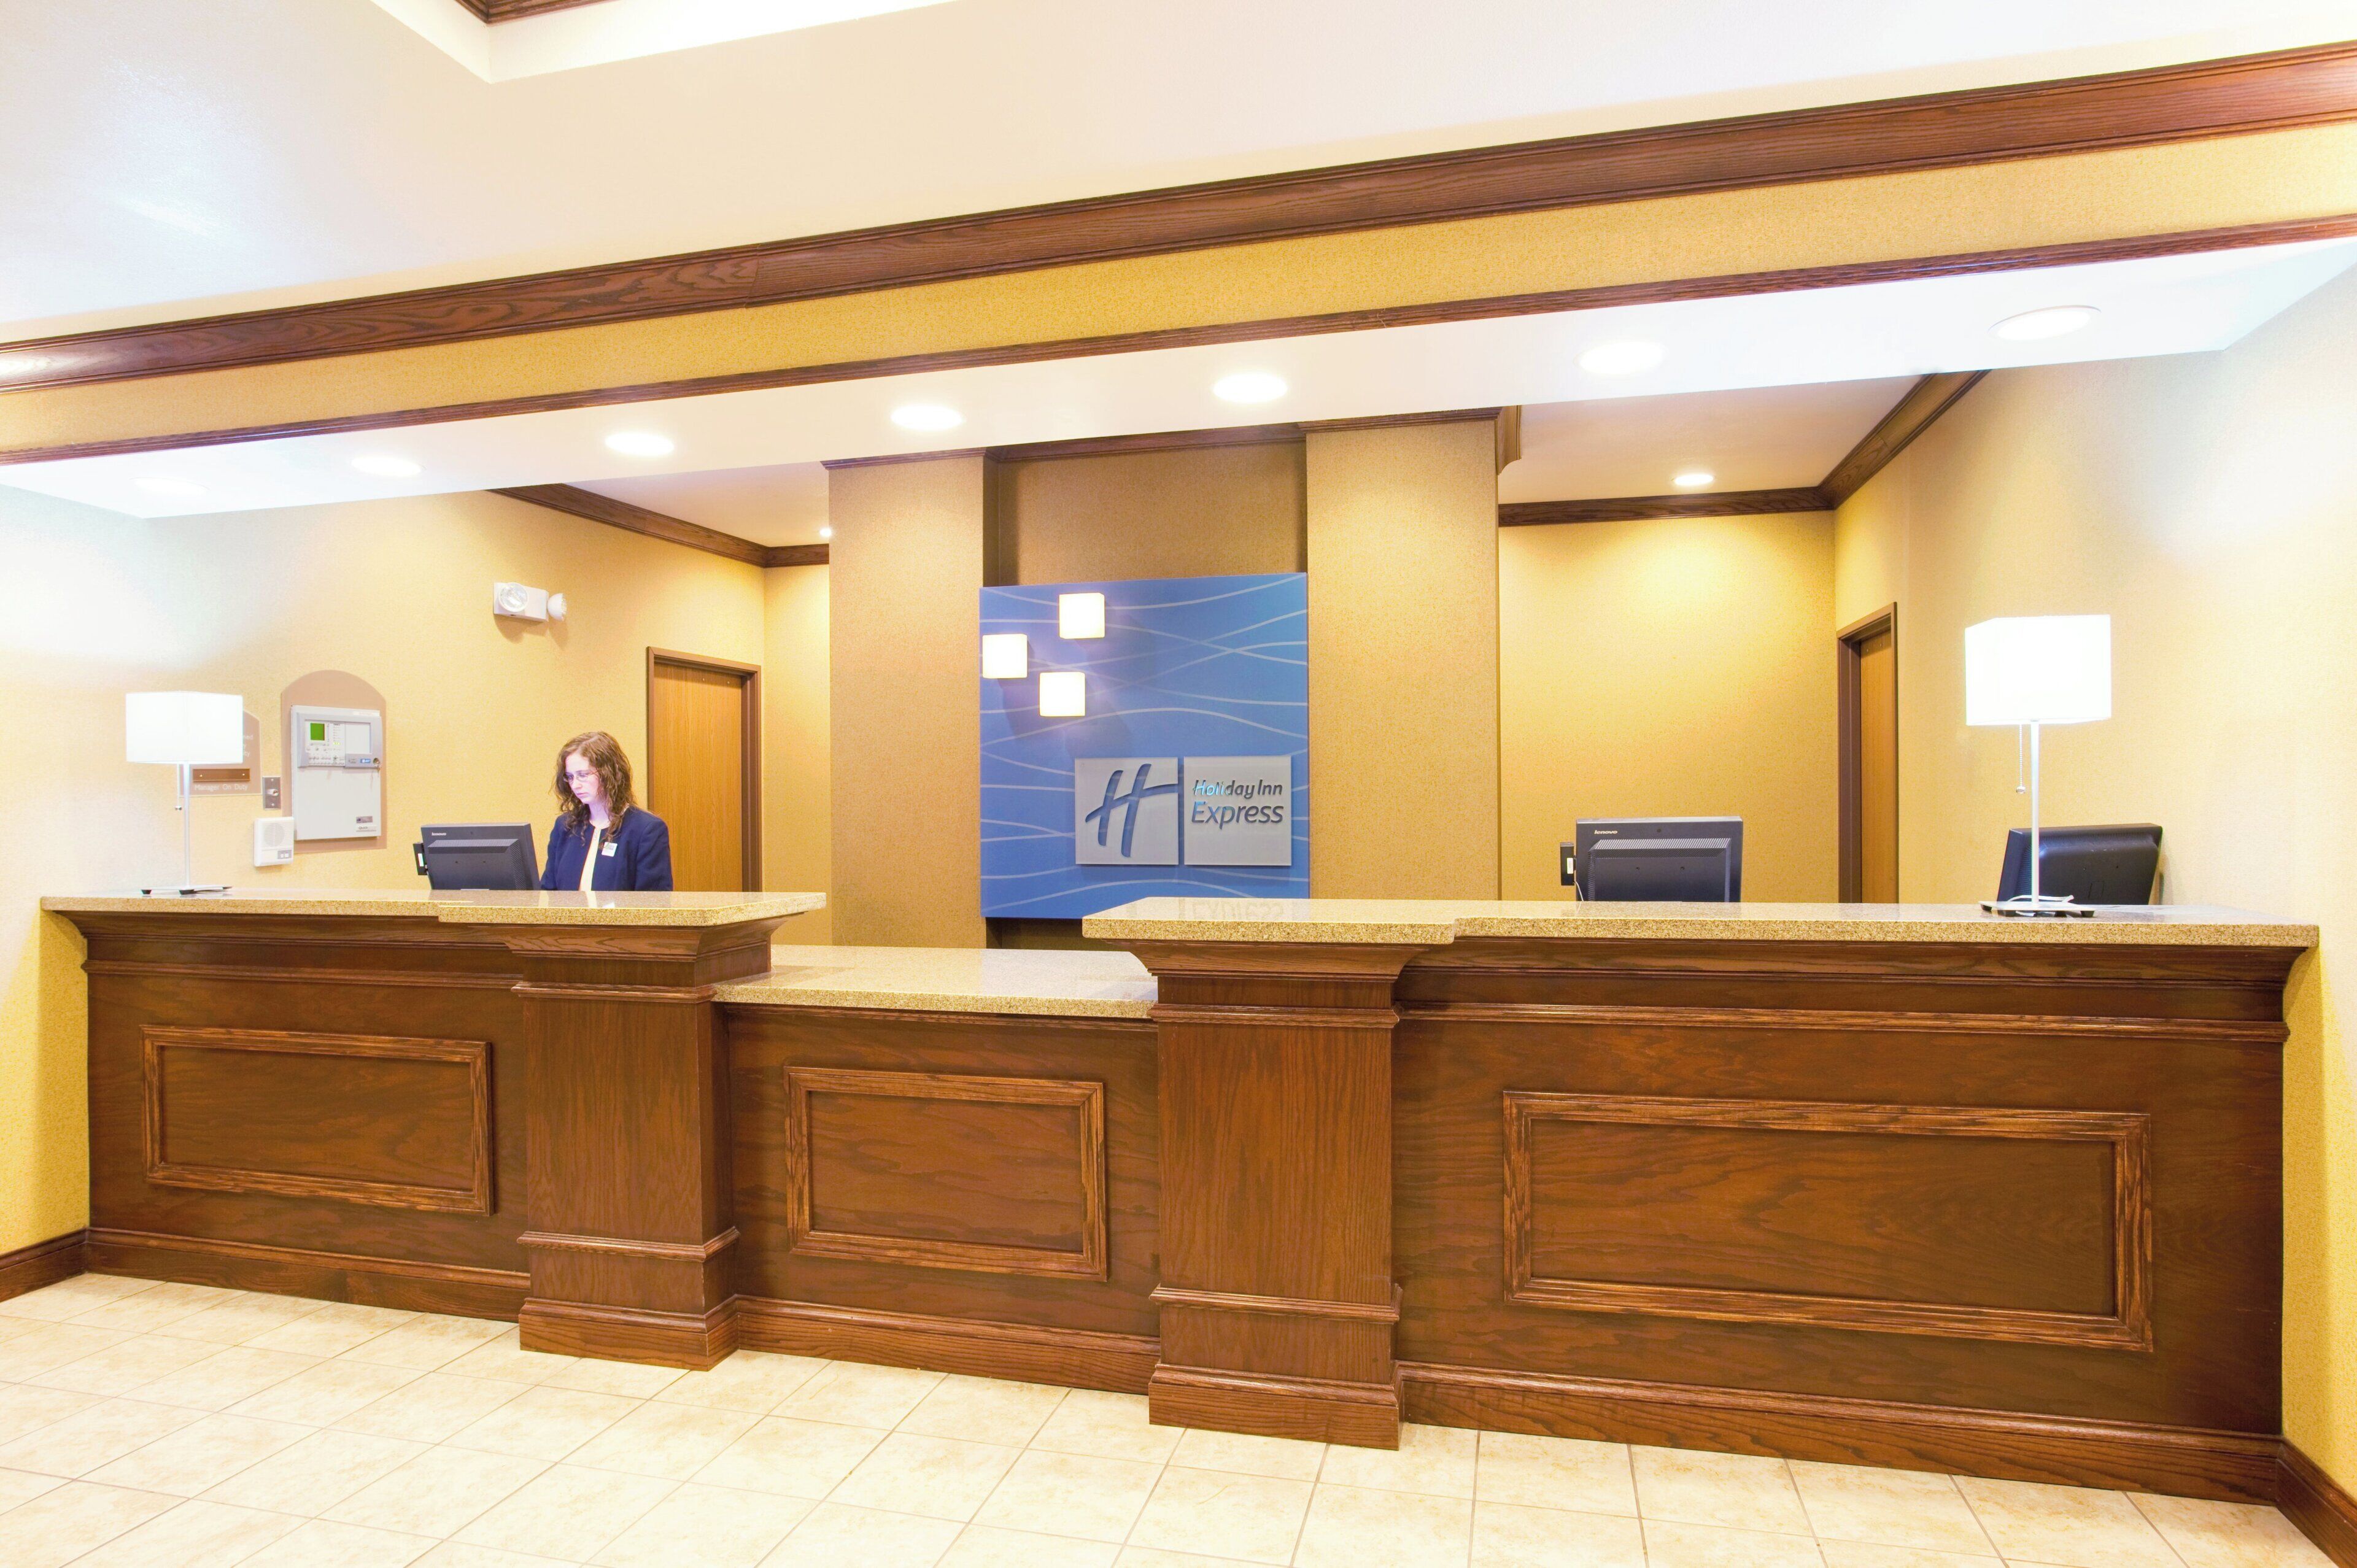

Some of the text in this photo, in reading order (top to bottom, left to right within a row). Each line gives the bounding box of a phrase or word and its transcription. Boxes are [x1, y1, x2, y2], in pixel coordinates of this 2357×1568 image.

[1193, 779, 1283, 799] Holiday Inn
[1191, 801, 1284, 830] Express
